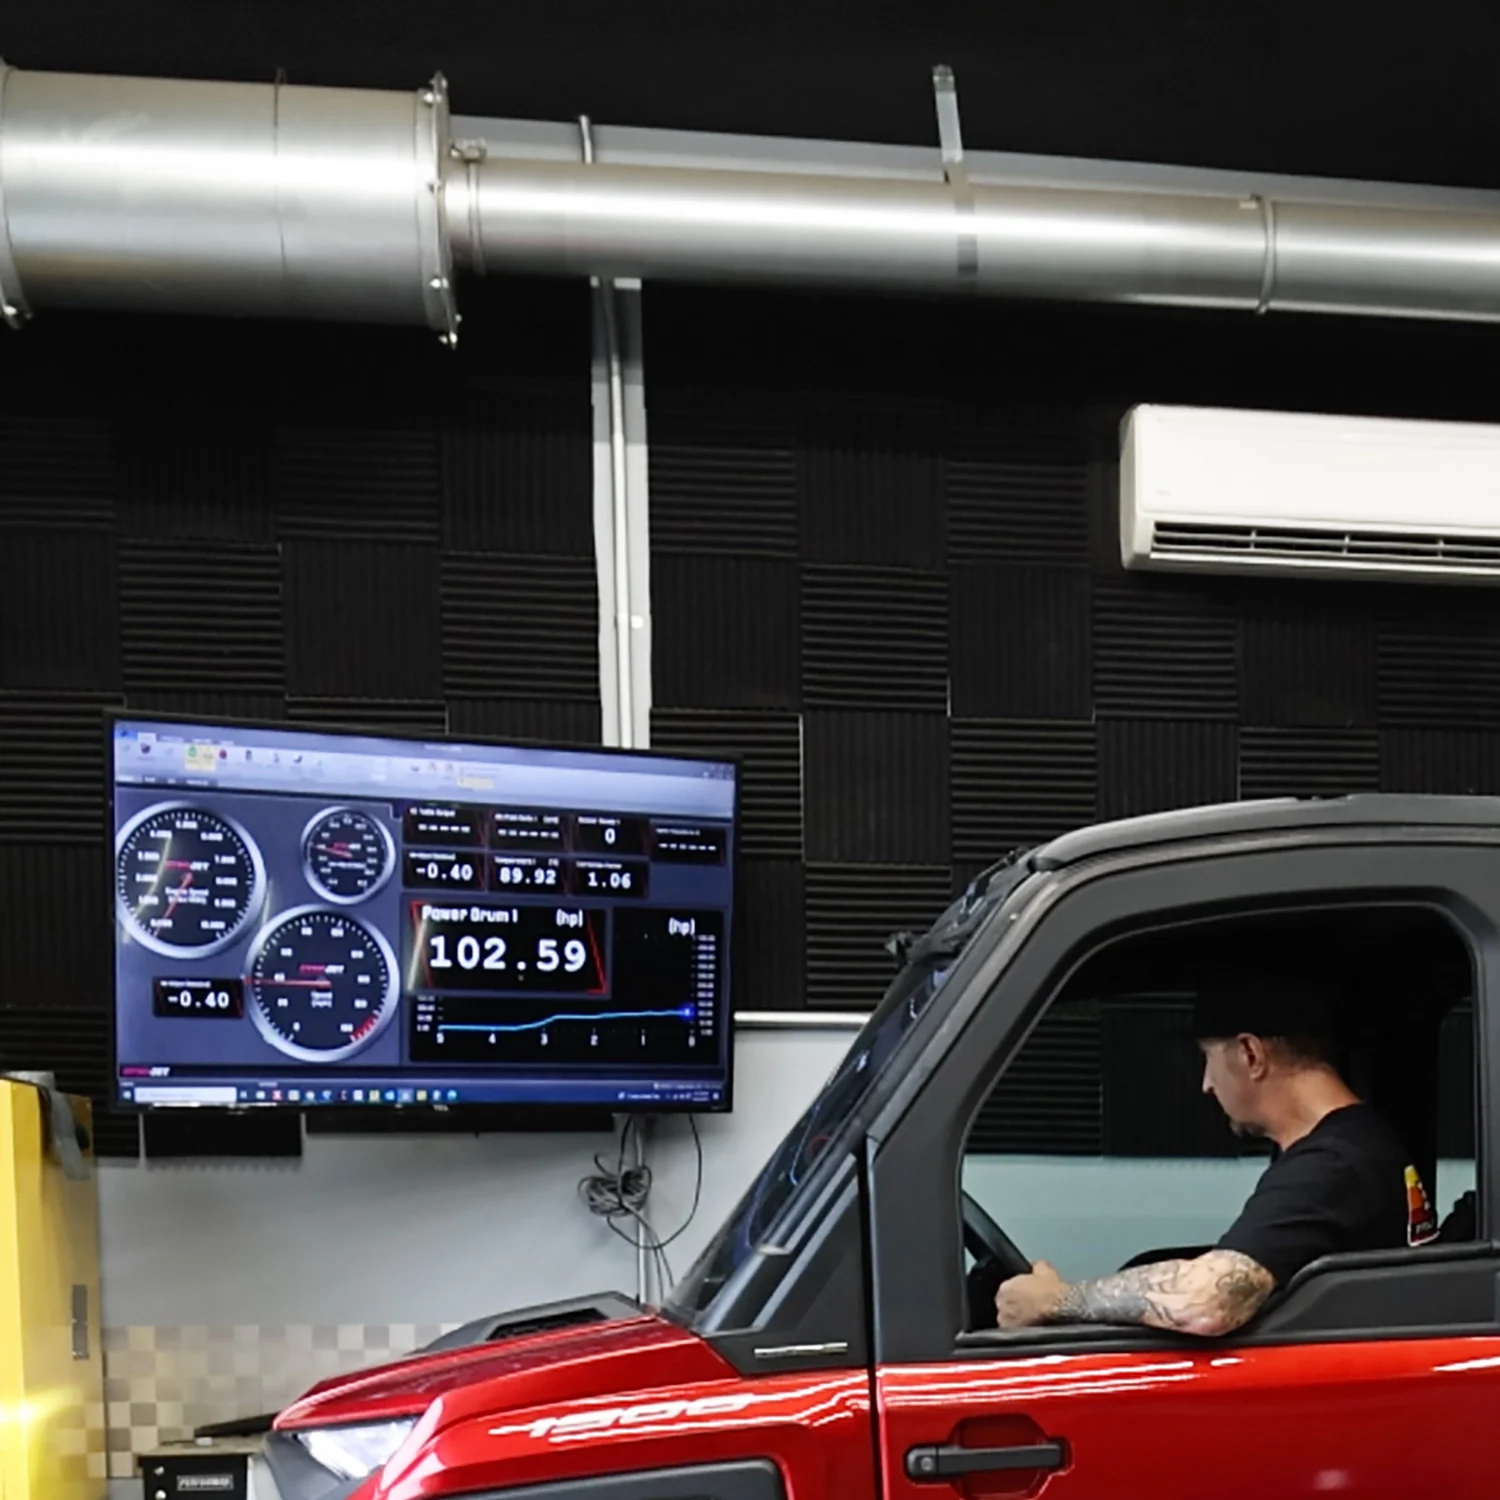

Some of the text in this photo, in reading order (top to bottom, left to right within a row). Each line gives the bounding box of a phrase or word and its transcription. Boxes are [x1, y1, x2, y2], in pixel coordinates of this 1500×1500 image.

[604, 828, 616, 845] 0
[415, 862, 473, 881] -0.40
[500, 866, 556, 885] 89.92
[588, 871, 632, 889] 1.06
[421, 905, 468, 922] Power
[470, 907, 510, 923] Drum
[429, 935, 586, 972] 102.59
[167, 990, 230, 1009] -0.40
